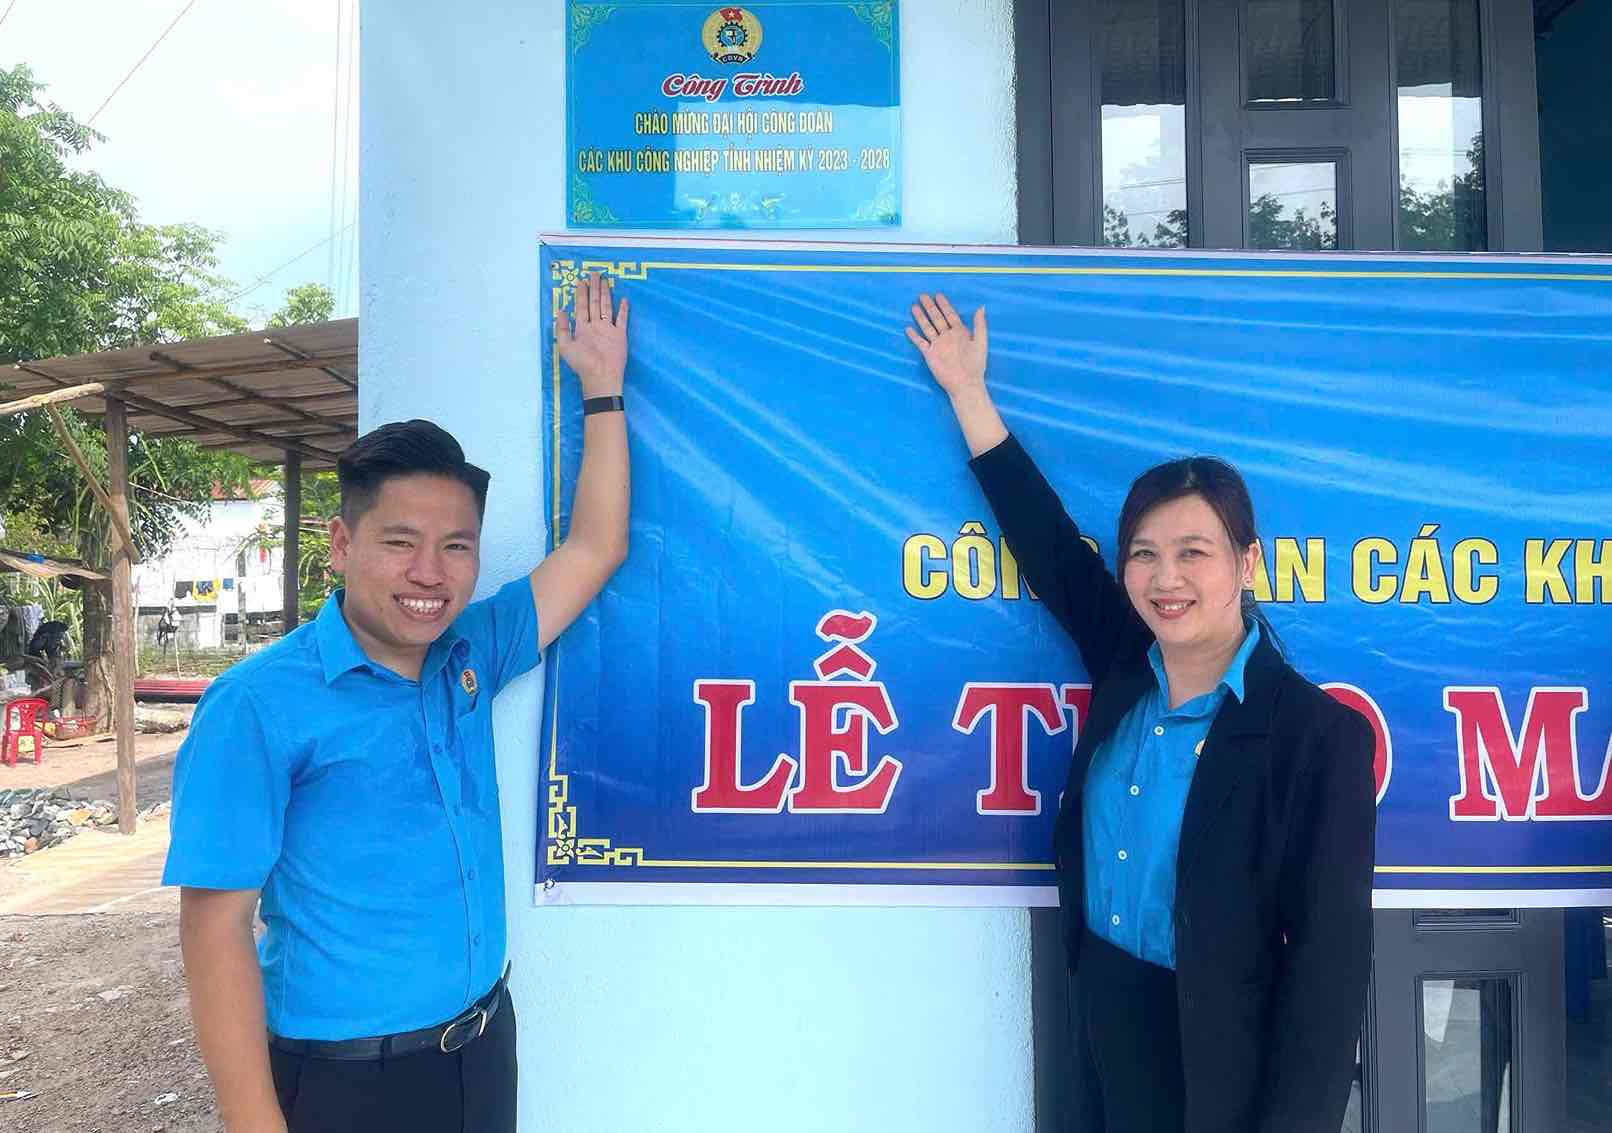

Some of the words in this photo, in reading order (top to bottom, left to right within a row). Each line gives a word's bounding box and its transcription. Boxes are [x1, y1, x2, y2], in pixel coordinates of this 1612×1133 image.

[661, 73, 728, 103] Công
[732, 71, 804, 97] Trình
[635, 108, 668, 134] CHÀO
[672, 107, 709, 135] MỪNG
[712, 111, 733, 139] ĐẠI
[737, 105, 758, 142] HỘI
[762, 106, 796, 134] CÔNG
[799, 105, 833, 134] ĐOÀN
[578, 146, 603, 172] CÁC
[607, 149, 632, 172] KHU
[636, 145, 670, 172] CÔNG
[674, 147, 719, 176] NGHIỆP
[722, 143, 751, 172] TỈNH
[755, 145, 795, 176] NHIỆM
[818, 149, 848, 171] 2023
[1351, 523, 1499, 605] CÁC
[691, 608, 903, 814] LỄ
[1443, 686, 1612, 822] M
